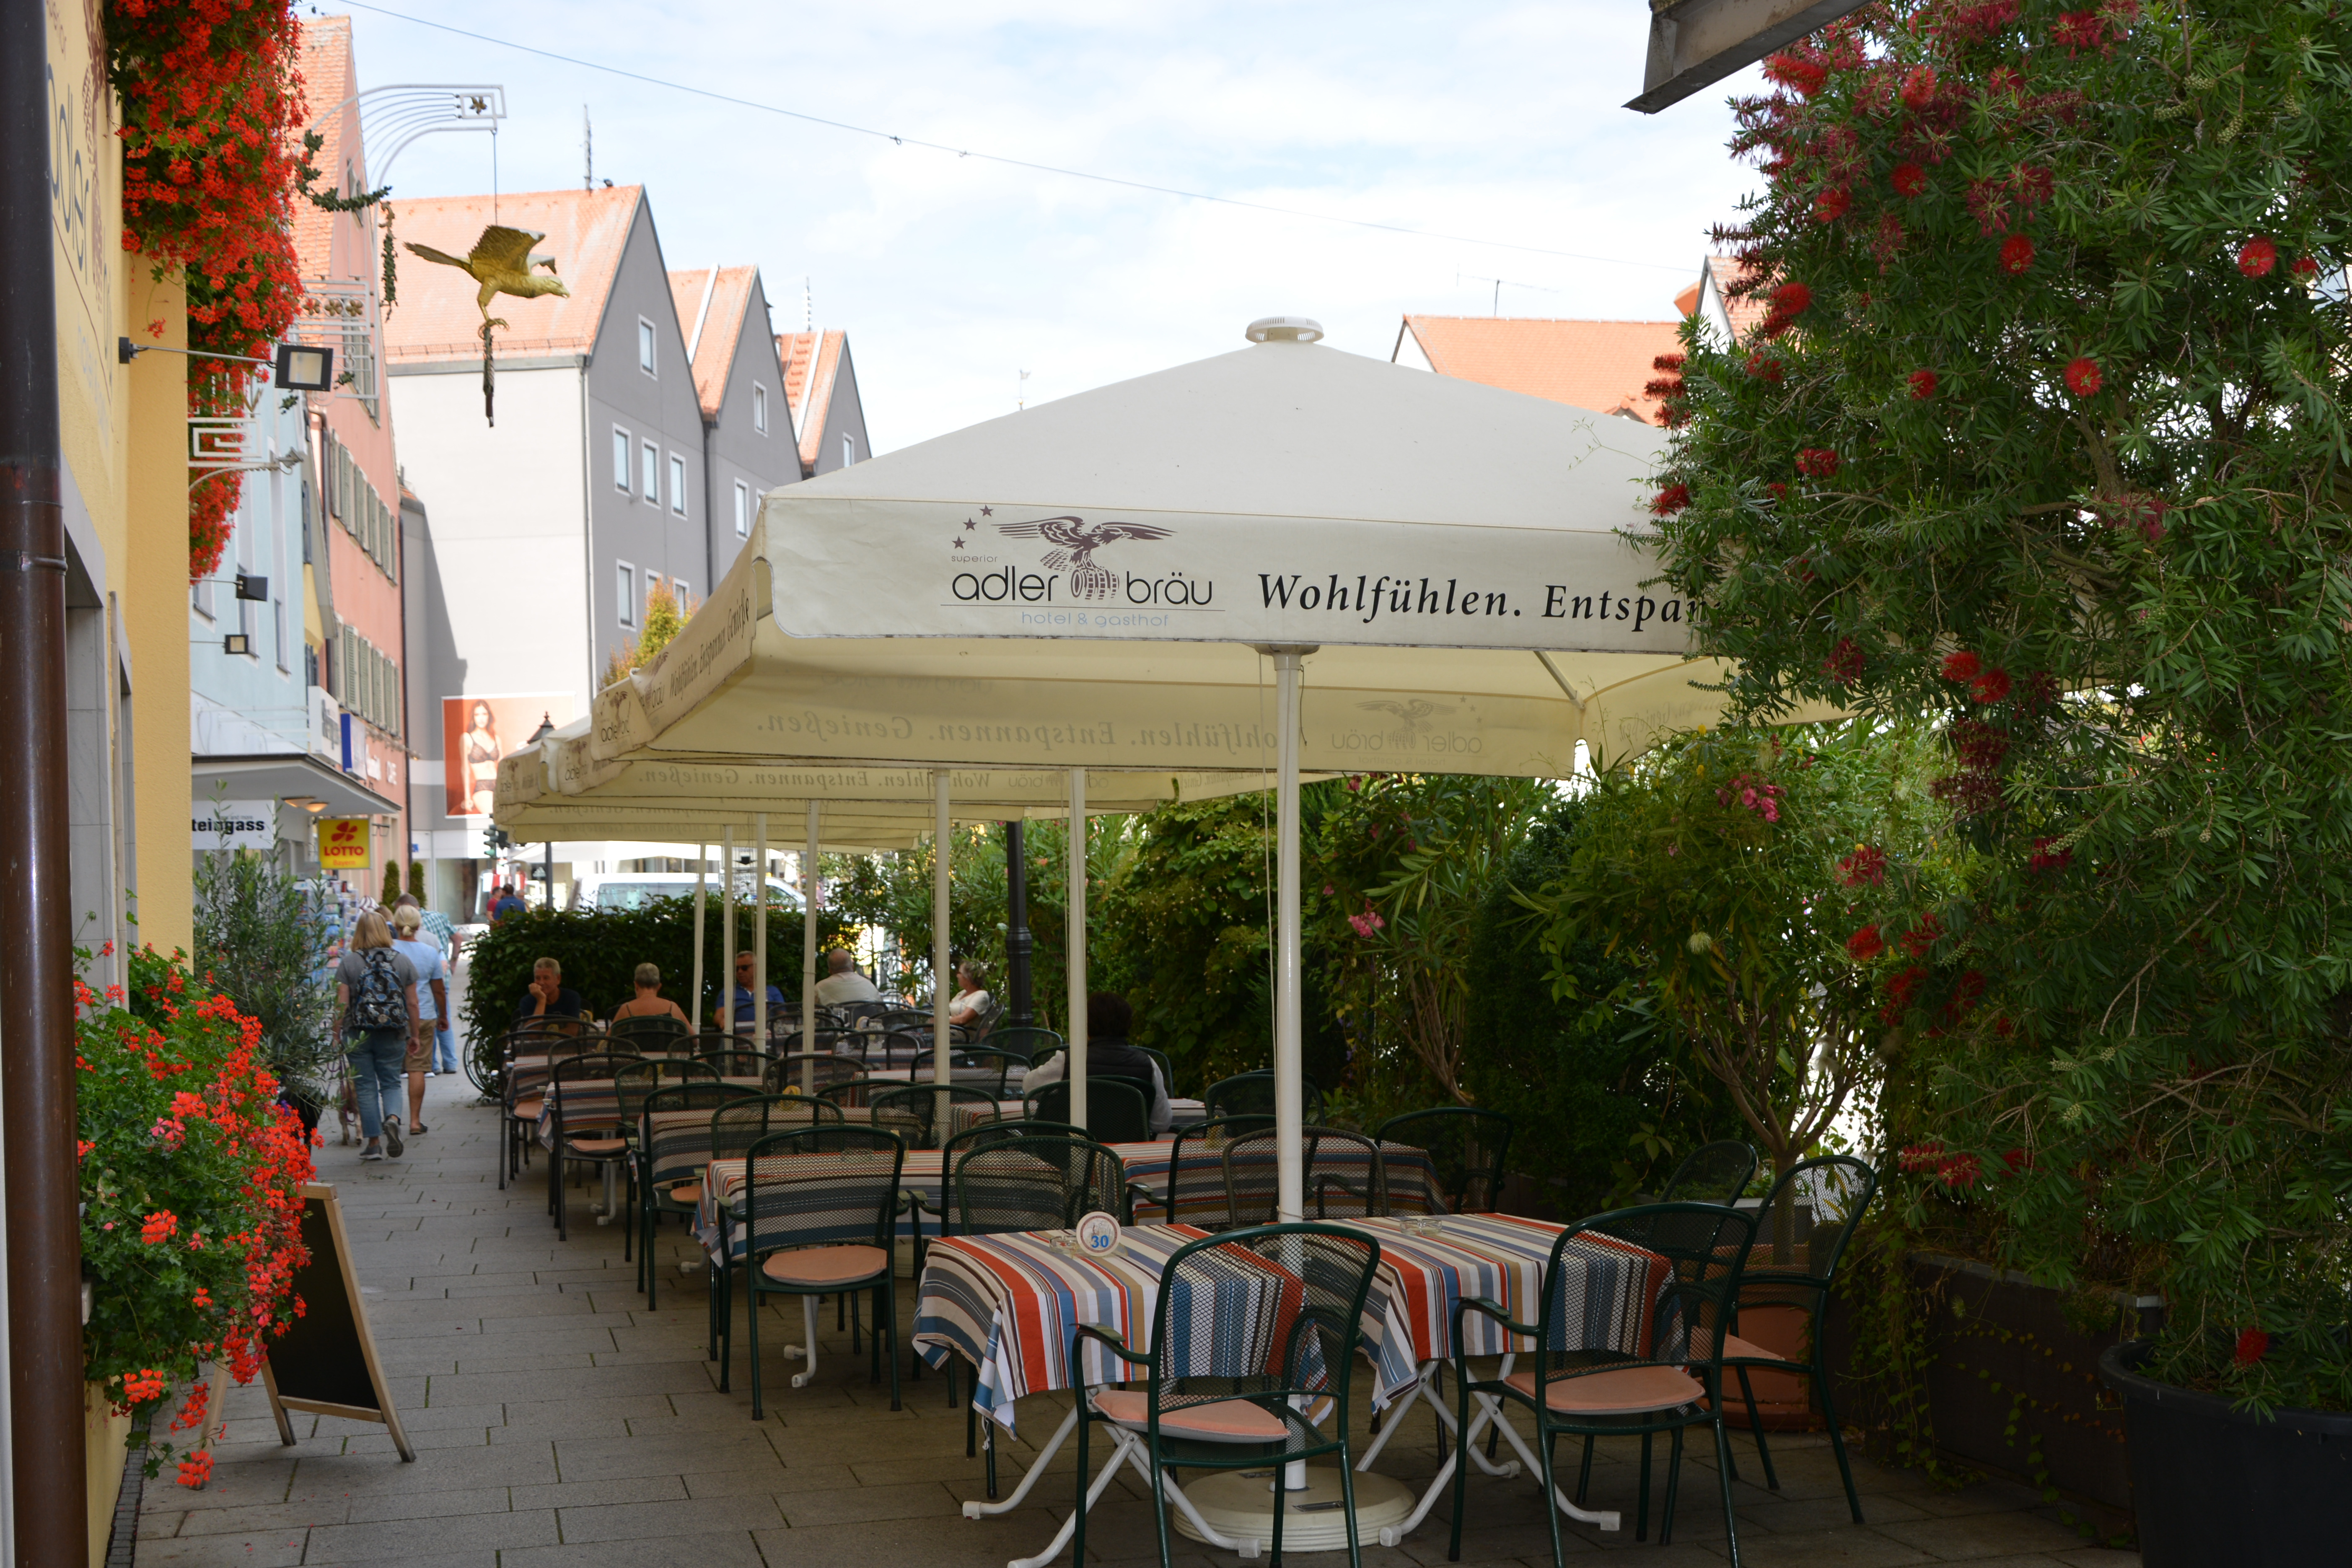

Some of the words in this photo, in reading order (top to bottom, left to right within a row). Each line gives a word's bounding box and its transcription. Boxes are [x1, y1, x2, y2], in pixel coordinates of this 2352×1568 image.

[951, 555, 998, 564] superior
[952, 565, 1059, 601] adler
[1126, 570, 1212, 605] bräu
[1258, 573, 1521, 623] Wohlfühlen.
[1022, 612, 1071, 625] hotel
[1078, 612, 1088, 625] &
[1094, 614, 1169, 628] gasthof
[192, 818, 265, 835] teingass
[324, 846, 365, 856] LOTTO
[1091, 1234, 1109, 1248] 30
